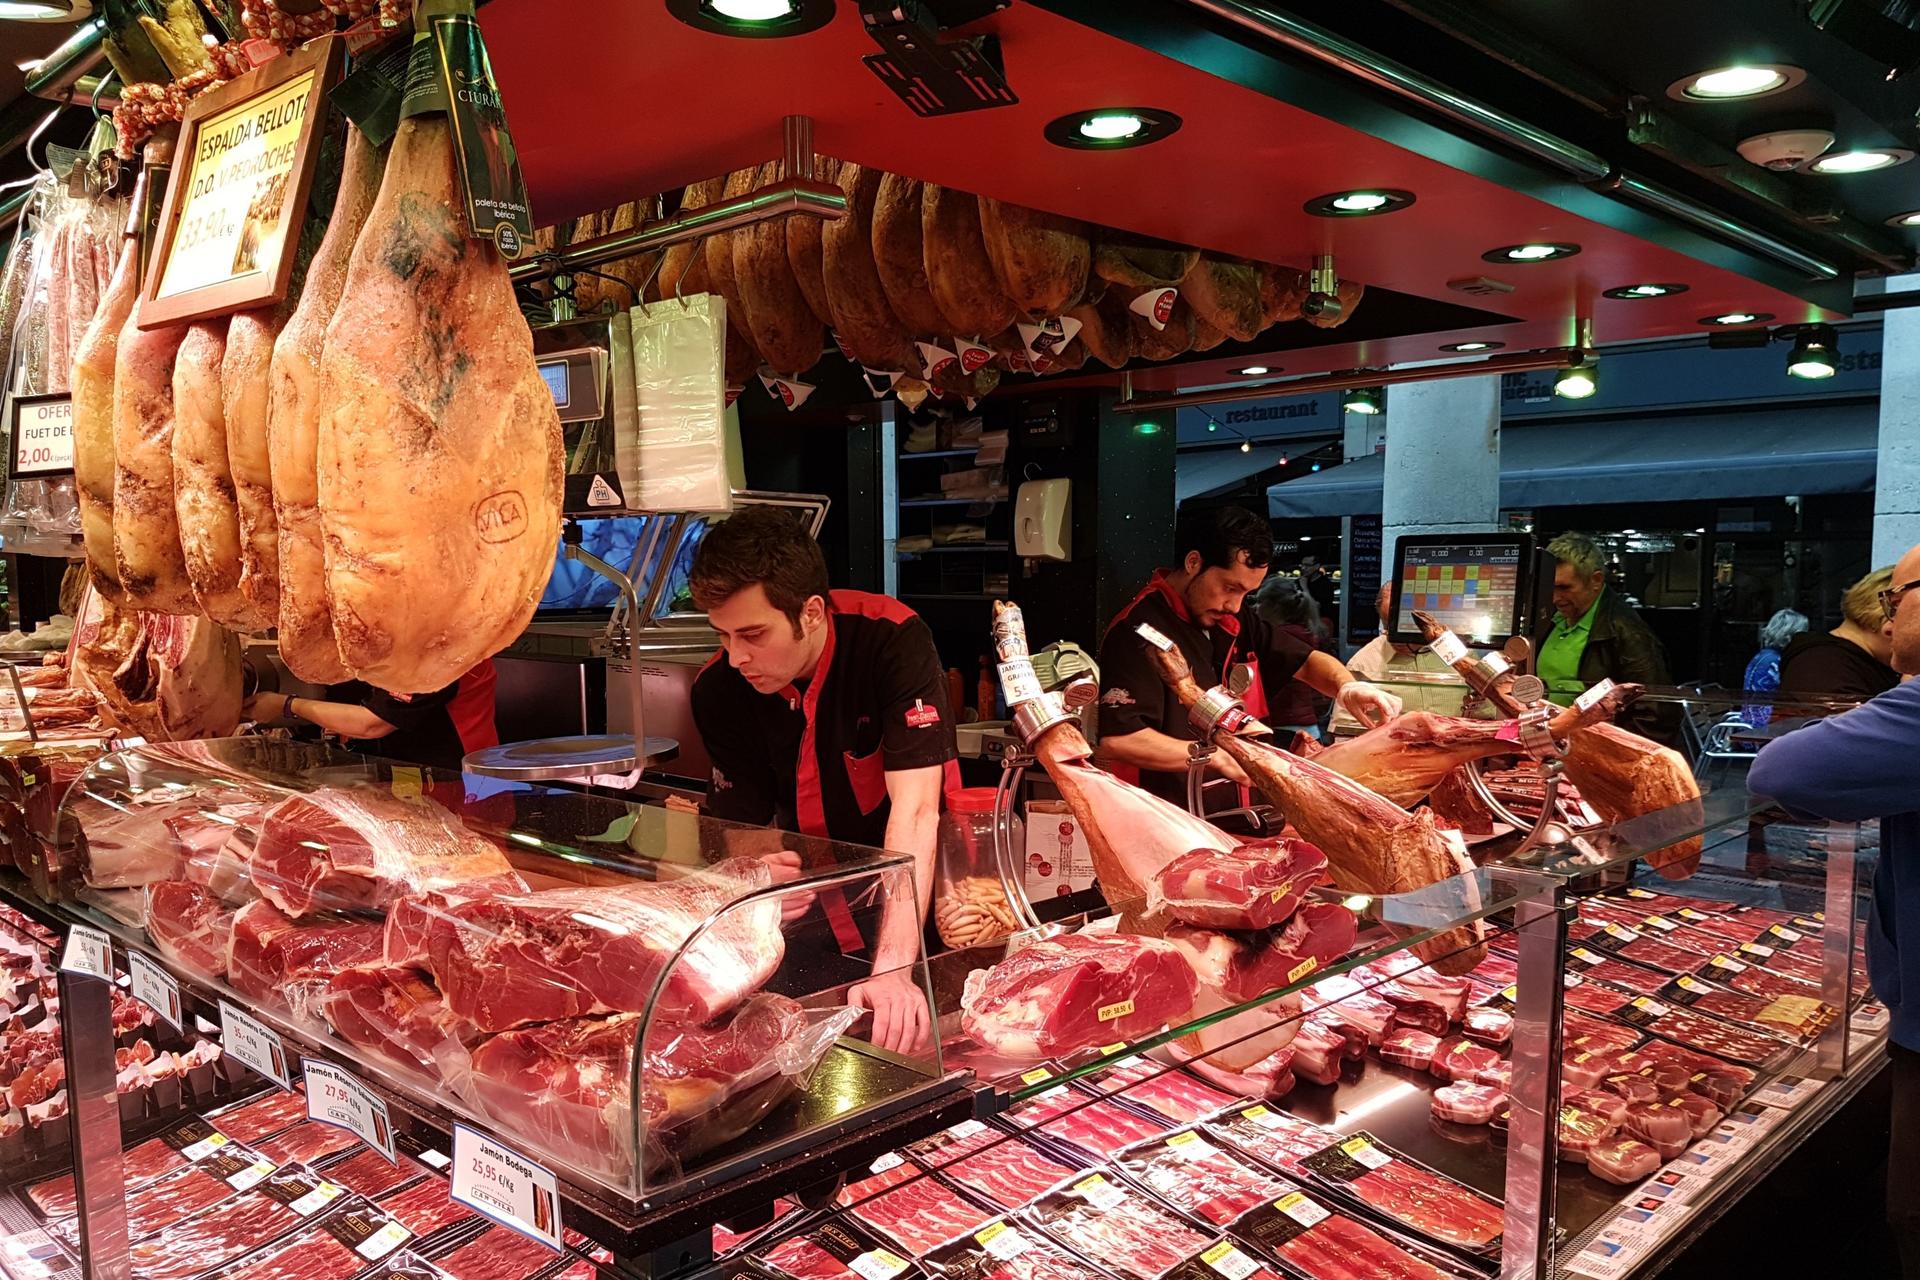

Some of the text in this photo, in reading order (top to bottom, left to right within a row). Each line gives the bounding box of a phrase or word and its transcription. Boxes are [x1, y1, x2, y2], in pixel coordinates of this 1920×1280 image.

[200, 119, 252, 163] ESPALDA
[194, 173, 215, 199] D.O.
[475, 199, 526, 213] paleta de bellota
[1225, 400, 1318, 424] restaurant
[26, 427, 50, 439] FUET
[53, 425, 67, 437] DE
[19, 447, 50, 466] 2,00
[305, 1064, 333, 1079] Jamón
[334, 1072, 357, 1092] Reserva
[325, 1084, 349, 1103] 27,95
[480, 1143, 533, 1178] Jamón Bodega
[472, 1158, 496, 1181] 25,95
[498, 1174, 514, 1194] €/Kg
[474, 1190, 490, 1201] CAN
[492, 1198, 512, 1213] VILA
